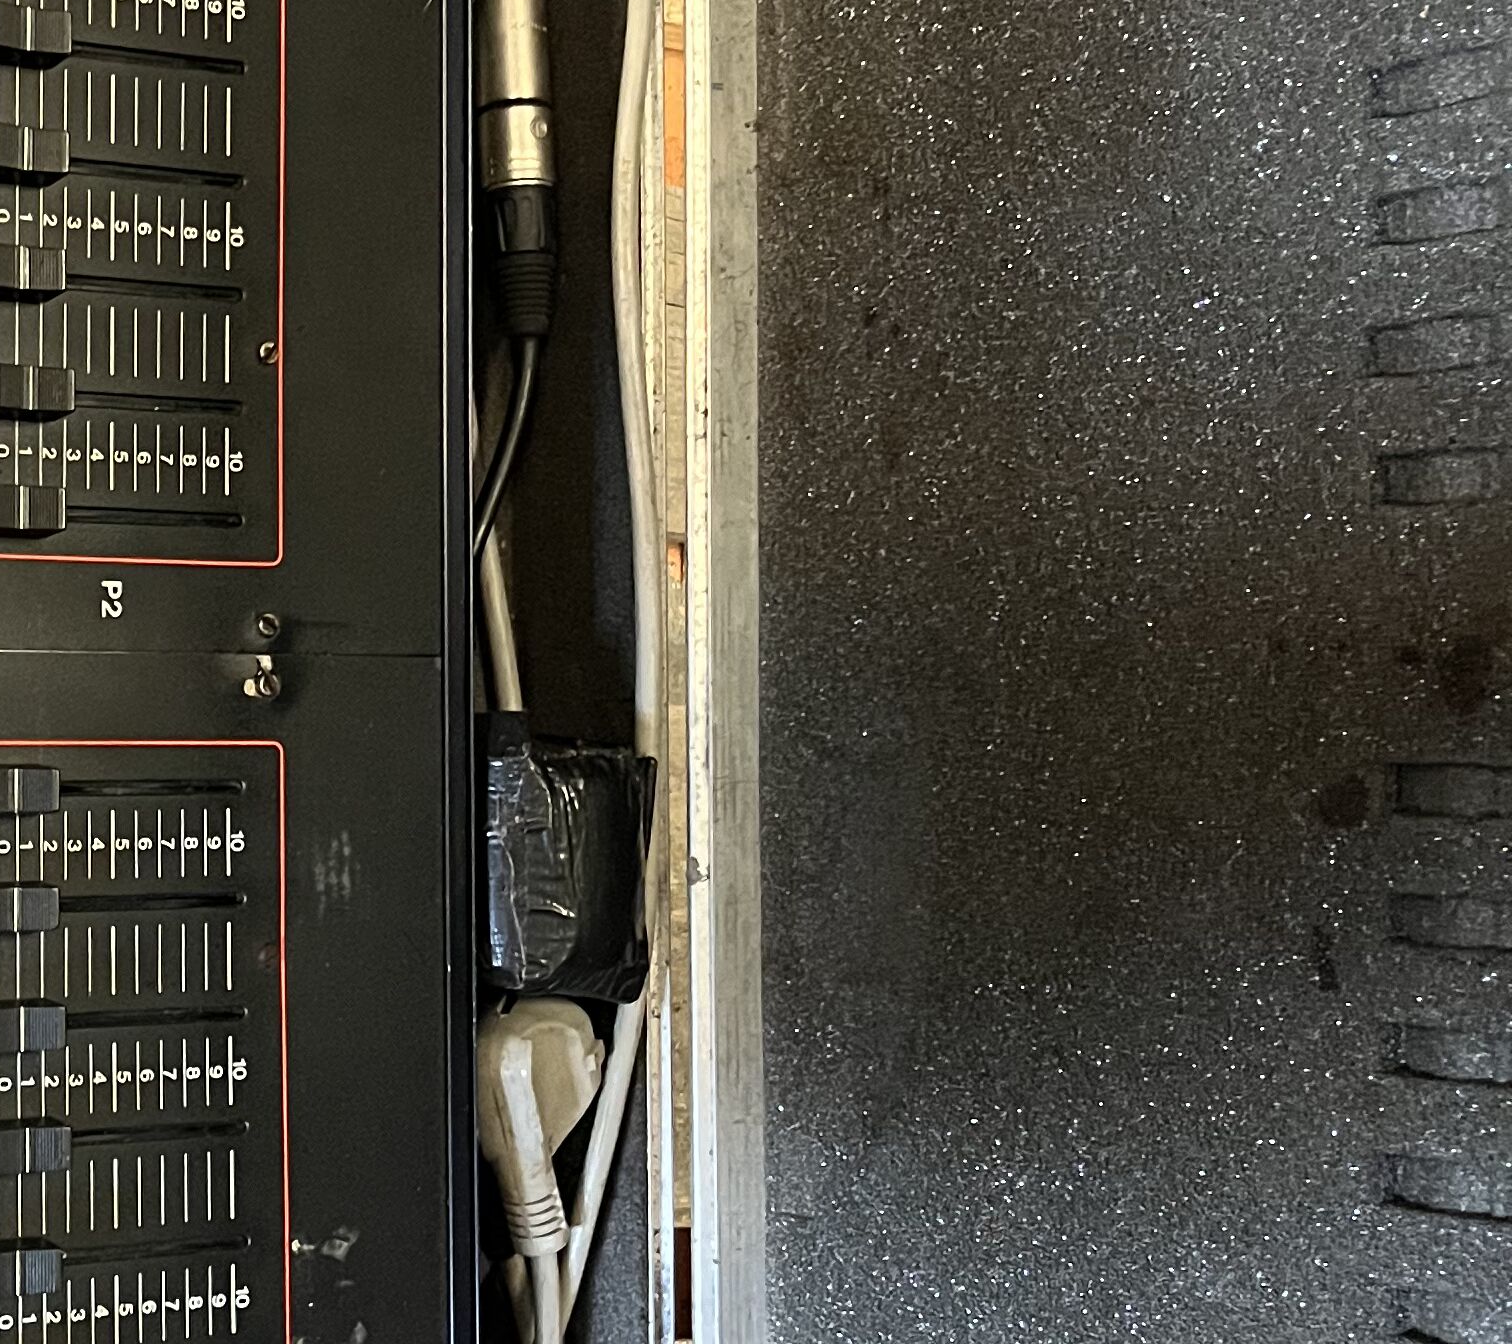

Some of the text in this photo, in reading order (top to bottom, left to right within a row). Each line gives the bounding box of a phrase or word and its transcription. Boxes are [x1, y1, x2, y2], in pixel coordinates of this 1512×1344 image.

[41, 446, 58, 460] 2
[65, 447, 82, 462] 3
[89, 447, 105, 462] 4
[113, 450, 130, 464] 5
[136, 450, 152, 465] 6
[159, 453, 174, 466] 7
[181, 453, 198, 467] 8
[205, 454, 221, 469] 9
[229, 450, 244, 473] 10
[100, 581, 125, 619] P2
[43, 839, 59, 853] 2
[67, 839, 83, 853] 3
[91, 837, 106, 852] 4
[115, 837, 130, 851] 5
[137, 836, 153, 851] 6
[160, 837, 176, 850] 7
[183, 836, 199, 850] 8
[206, 835, 222, 850] 9
[229, 829, 246, 853] 10
